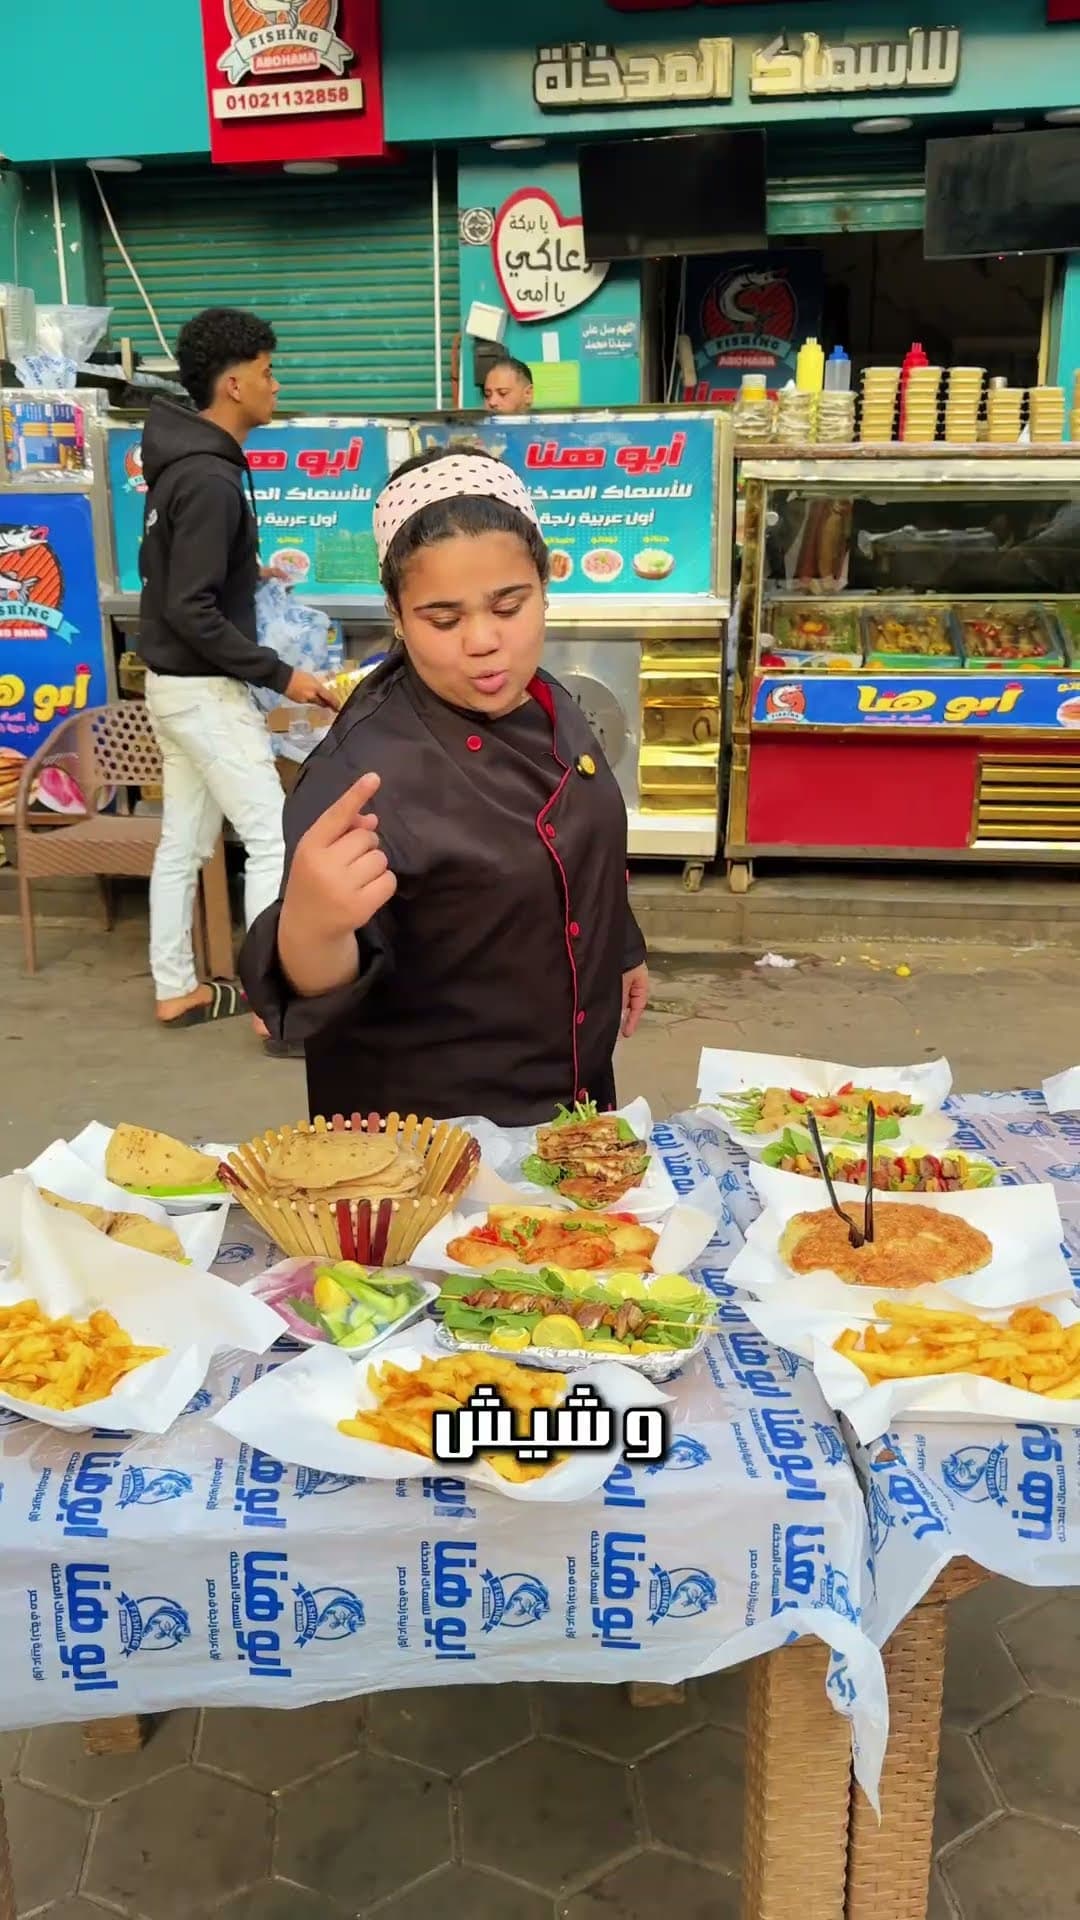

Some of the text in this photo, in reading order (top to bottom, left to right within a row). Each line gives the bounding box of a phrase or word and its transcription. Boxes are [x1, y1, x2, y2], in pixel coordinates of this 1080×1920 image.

[250, 29, 319, 49] FISHING
[534, 38, 734, 110] المدخنة
[226, 86, 349, 110] 01021132858
[509, 214, 549, 234] يا بركة
[554, 282, 565, 307] يا
[296, 437, 363, 478] أبو
[525, 432, 687, 474] أبو هنا
[285, 484, 372, 500] للأسماك
[530, 480, 693, 499] للأسماك المدخ
[265, 512, 306, 527] عربية
[310, 512, 337, 527] أول
[539, 509, 656, 527] أول عربية رنجة
[857, 685, 937, 712] هنا
[729, 1333, 792, 1397] ابو هنا
[74, 1451, 125, 1494] هنا
[760, 1408, 826, 1501] ابو هنا
[1011, 1423, 1062, 1541] بو هنا
[56, 1498, 108, 1538] ابو
[234, 1487, 287, 1529] ابو
[785, 1525, 825, 1595] هنا
[424, 1541, 477, 1660] ابو هنا
[490, 1583, 503, 1622] FISHING
[592, 1532, 646, 1650] ابو هنا
[659, 1576, 670, 1614] FISHING
[59, 1563, 118, 1692] ابو هنا
[128, 1606, 141, 1648] FISHING
[236, 1551, 292, 1678] ابو هنا
[305, 1597, 317, 1635] FISHING
